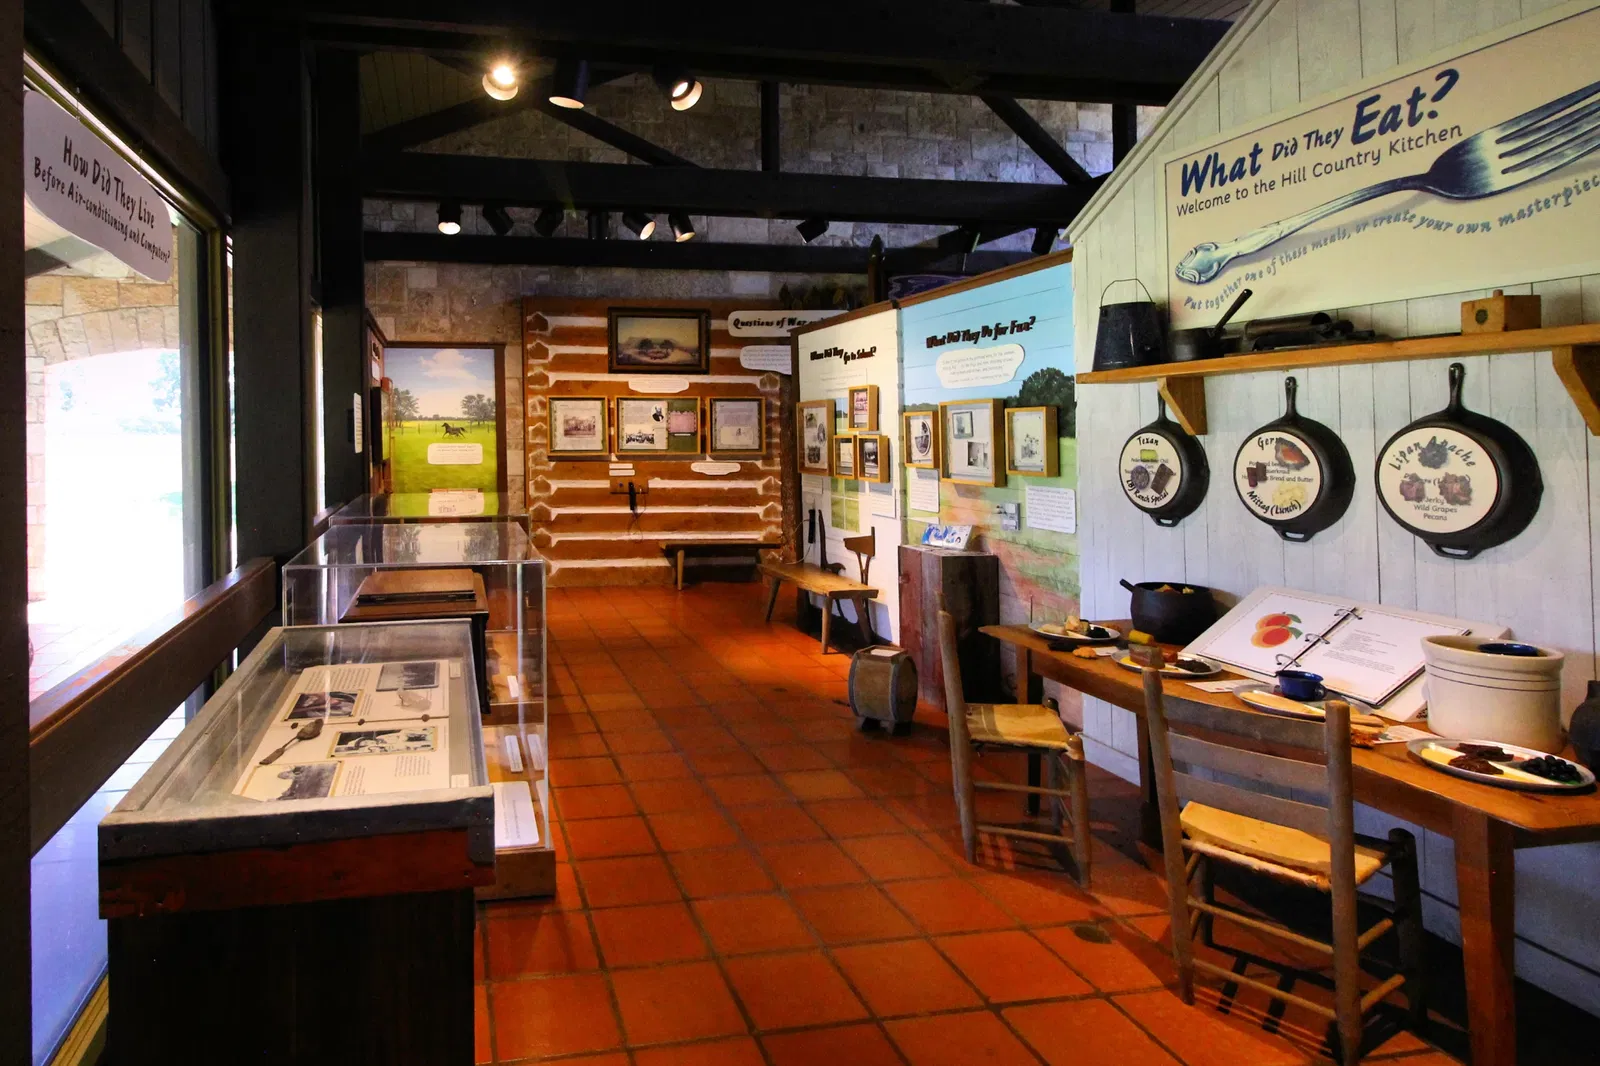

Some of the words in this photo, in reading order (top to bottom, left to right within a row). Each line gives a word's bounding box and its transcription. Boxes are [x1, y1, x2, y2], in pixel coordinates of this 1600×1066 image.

[1181, 142, 1263, 197] What
[1272, 137, 1298, 161] Did
[1303, 126, 1344, 151] They
[1350, 68, 1460, 145] Eat?
[63, 135, 89, 178] How
[92, 158, 111, 196] Did
[113, 176, 136, 221] They
[138, 195, 155, 229] Live
[1176, 192, 1231, 217] Welcome
[1235, 186, 1248, 200] to
[1254, 179, 1275, 195] the
[1281, 166, 1306, 187] Hill
[1312, 149, 1381, 179] Country
[1388, 125, 1463, 156] Kitchen
[34, 156, 65, 195] Before
[67, 182, 128, 242] Air-conditioning
[129, 228, 140, 244] and
[140, 232, 171, 263] Computers?
[1184, 296, 1202, 310] Put
[1205, 276, 1242, 310] together
[1244, 271, 1264, 282] one
[1266, 258, 1277, 276] of
[1279, 246, 1308, 266] these
[1311, 227, 1352, 250] meals,
[1356, 221, 1368, 234] or
[1372, 208, 1417, 228] create
[1413, 215, 1453, 232] your
[1456, 219, 1492, 234] own
[733, 317, 774, 330] Questions
[775, 316, 787, 329] of
[992, 322, 1008, 341] for
[1009, 315, 1036, 335] Fun?
[1137, 436, 1159, 446] Texan
[1388, 441, 1423, 471] Lipan
[1134, 488, 1150, 503] Ranch
[1150, 488, 1169, 506] Special
[1246, 490, 1270, 514] Mittag
[1270, 499, 1302, 516] (Lunch)
[1413, 504, 1430, 512] Wild
[1431, 504, 1458, 514] Grapes
[1423, 512, 1448, 521] Pecans
